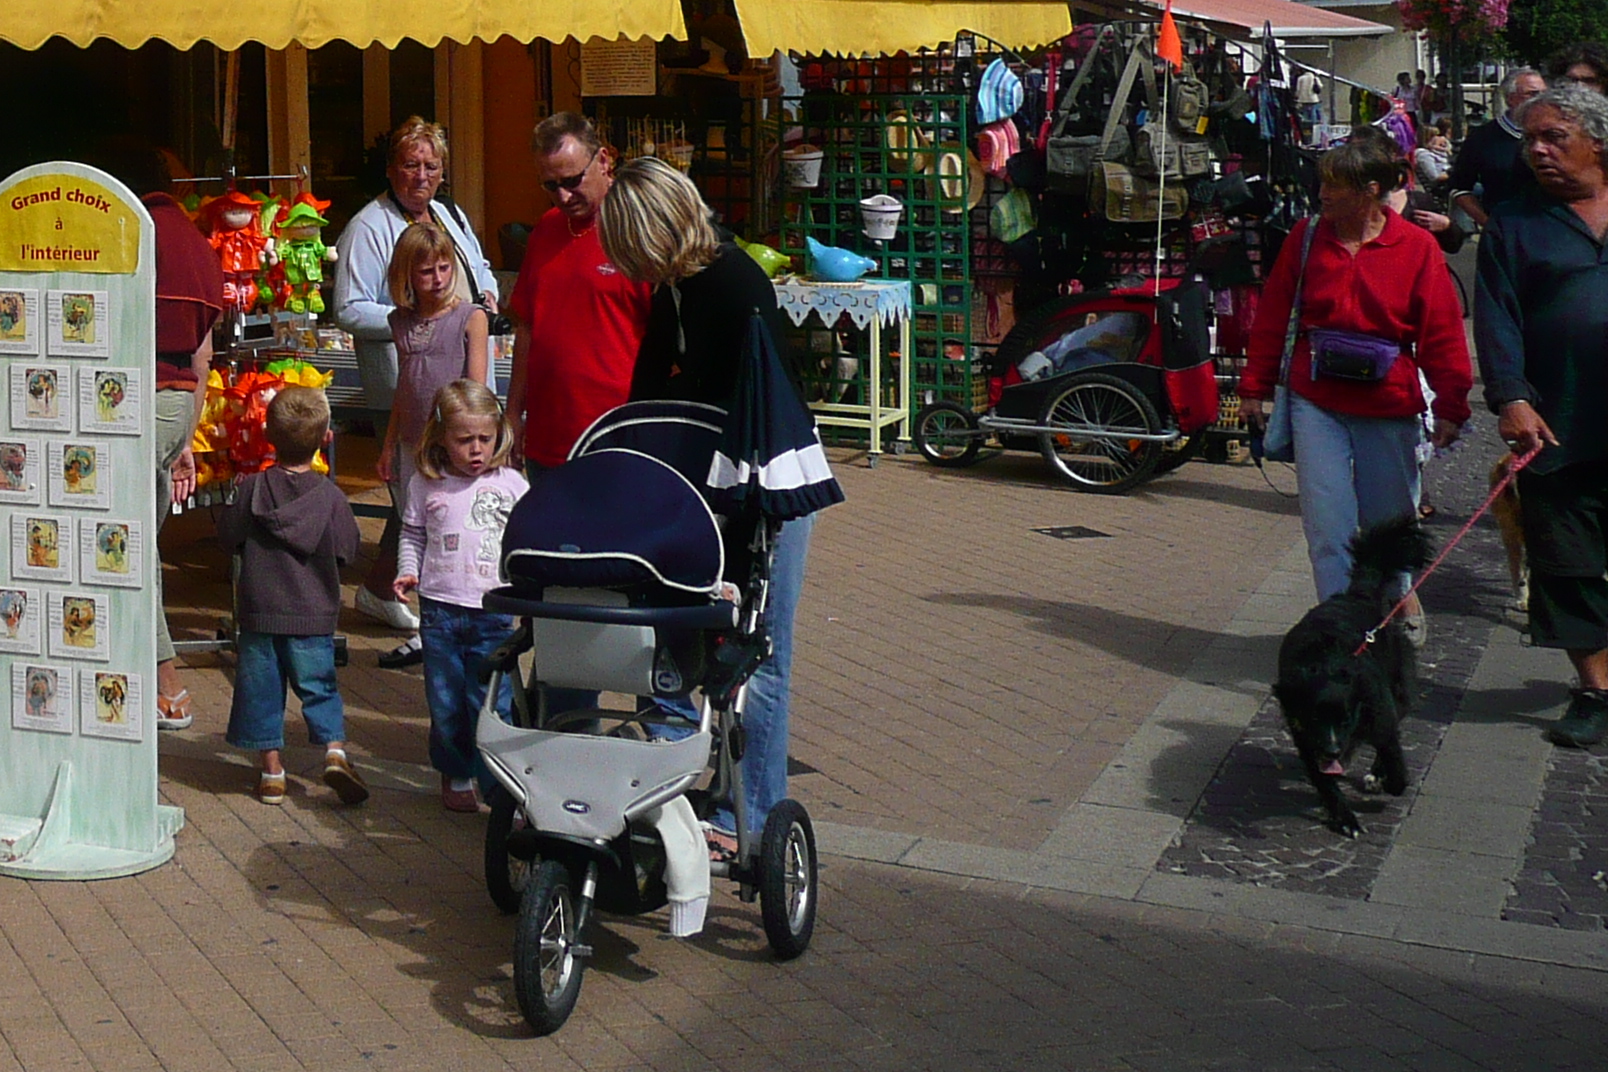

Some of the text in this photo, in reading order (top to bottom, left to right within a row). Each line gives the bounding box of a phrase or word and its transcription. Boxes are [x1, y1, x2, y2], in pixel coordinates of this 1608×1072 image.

[11, 187, 112, 214] Grand choix
[55, 217, 63, 230] à
[21, 244, 100, 261] l'intérieur
